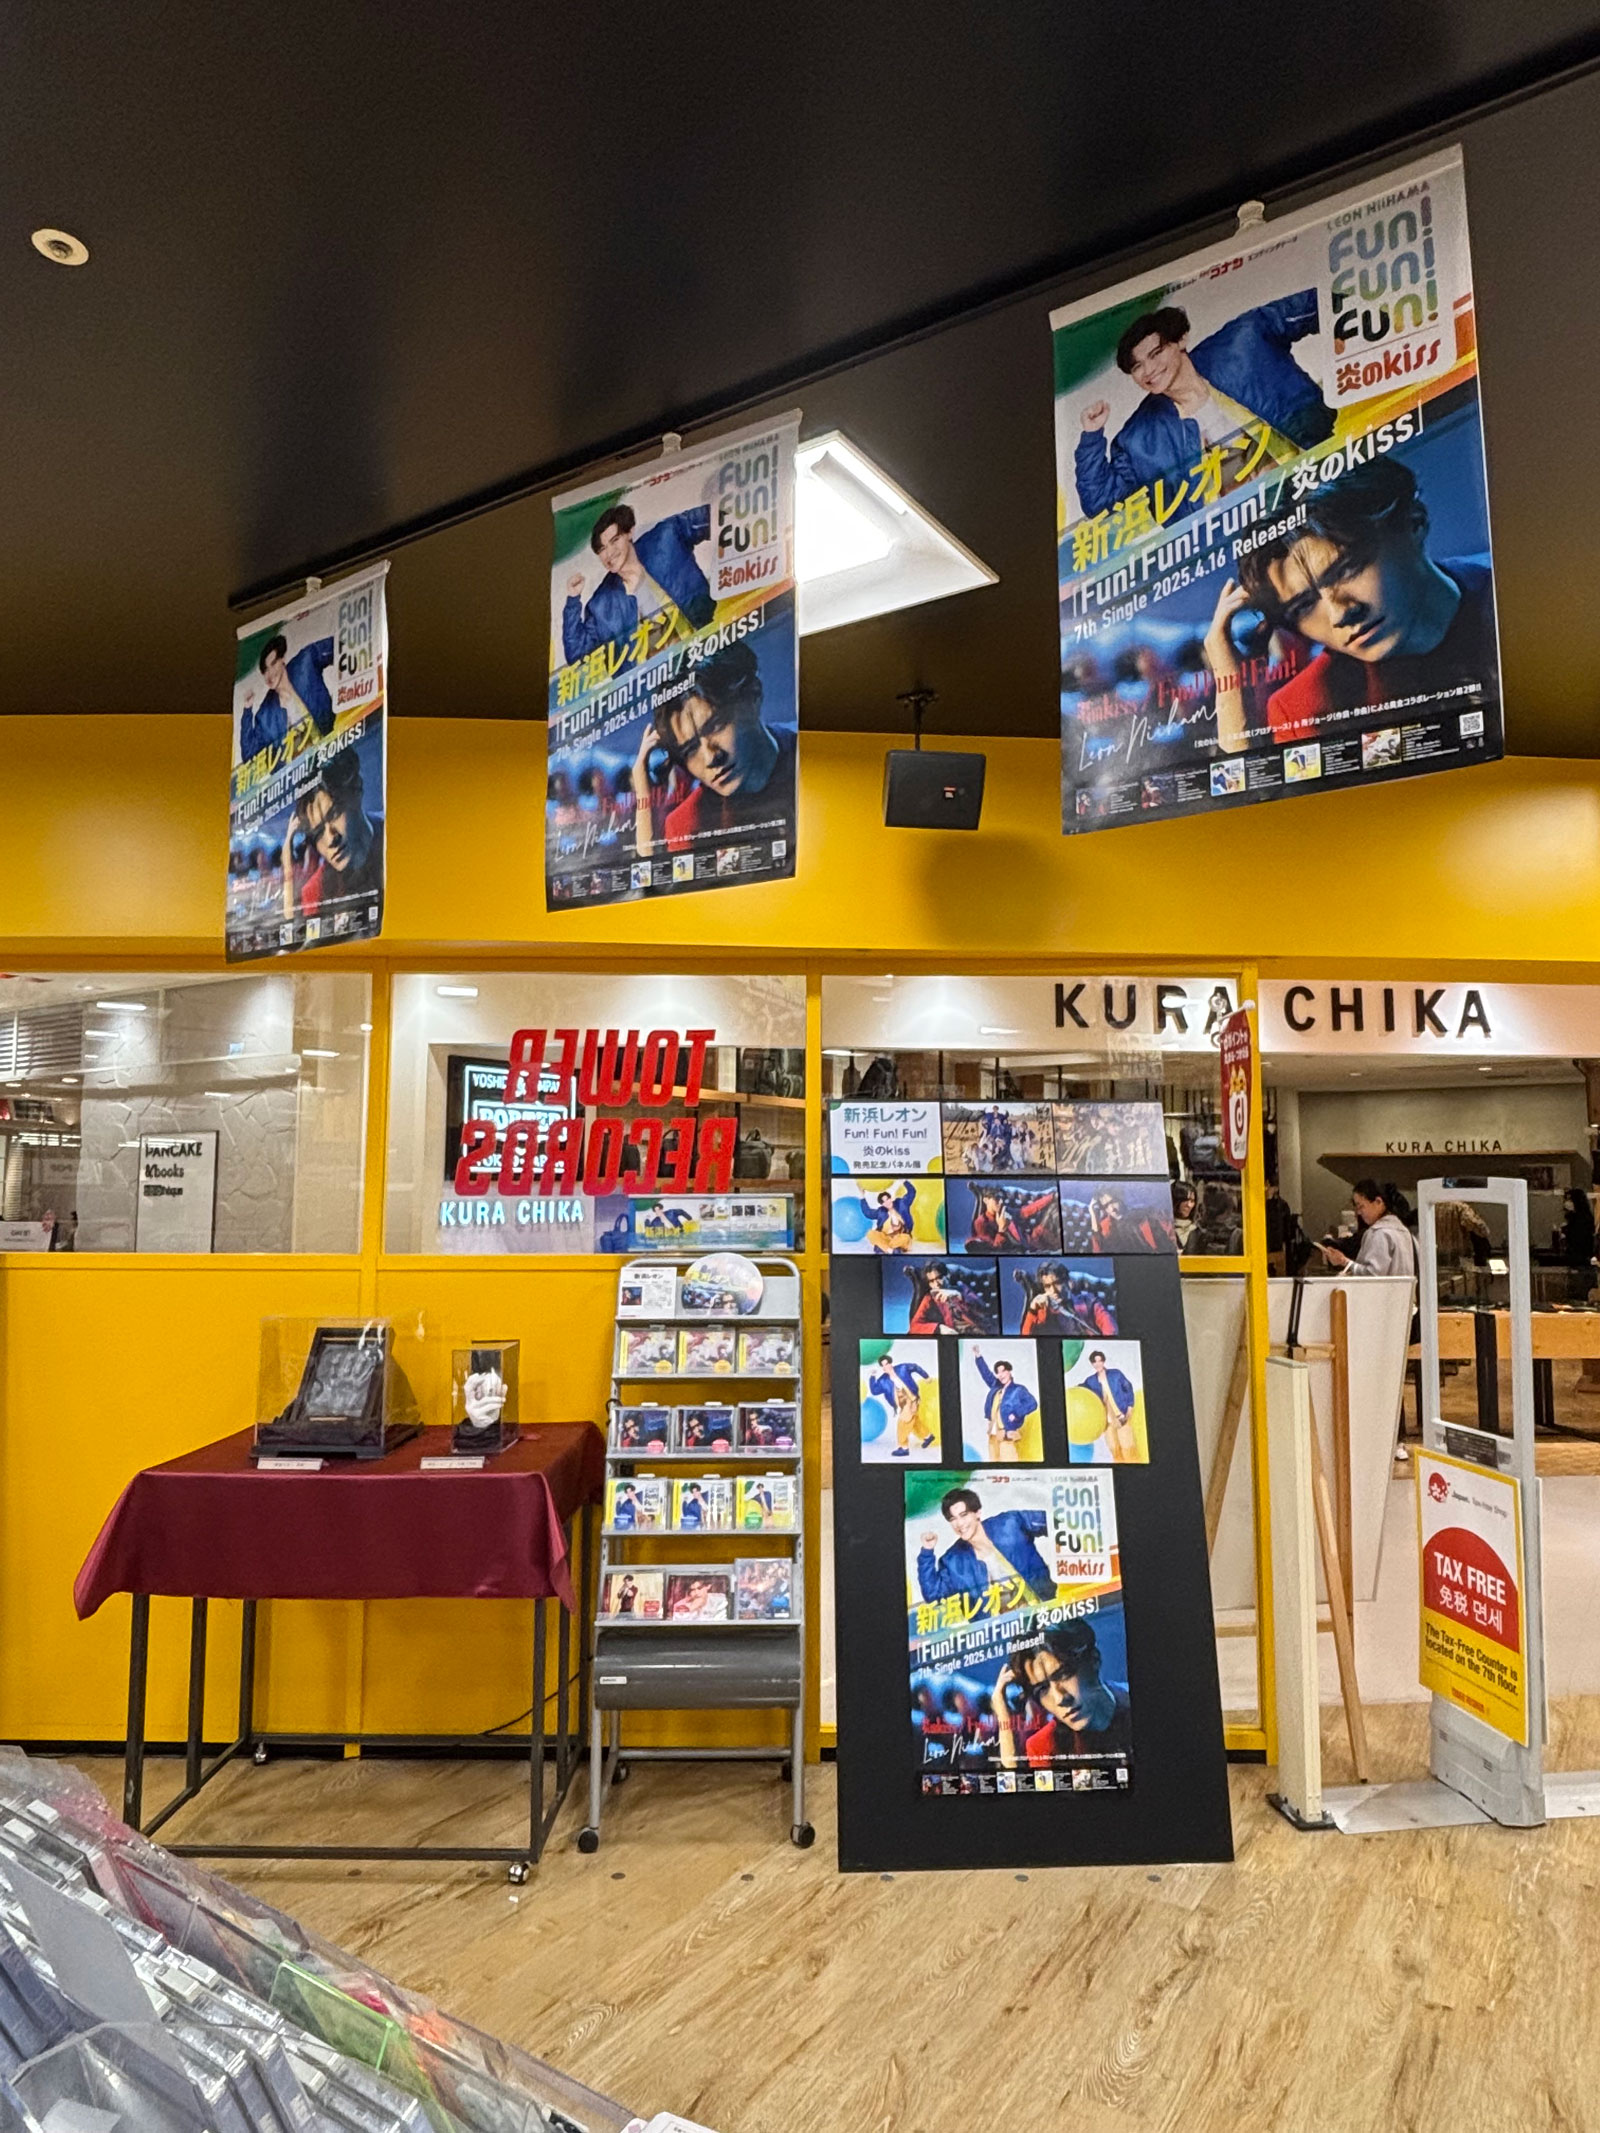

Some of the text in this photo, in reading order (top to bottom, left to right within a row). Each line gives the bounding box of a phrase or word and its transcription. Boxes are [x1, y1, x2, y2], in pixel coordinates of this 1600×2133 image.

[1072, 423, 1272, 573] 新浜レオン
[1074, 613, 1097, 644] 7th
[1101, 591, 1148, 629] Single
[1152, 552, 1227, 602] 2025.4.16
[557, 605, 680, 707] 新浜レオン
[1055, 983, 1491, 1037] KURA CHIKA
[844, 1107, 927, 1124] 新浜レオン
[844, 1129, 928, 1139] Fun! Fun! Fun!
[145, 1141, 202, 1157] PANCAKE
[863, 1145, 911, 1157] 炎のkiss
[1385, 1140, 1502, 1153] KURA CHIKA
[441, 1199, 584, 1226] KURA CHIKA
[1434, 1551, 1506, 1606] TAX FREE
[916, 1577, 1026, 1636] 新浜レオン
[1440, 1584, 1503, 1635] 免税 면세
[934, 1658, 962, 1677] Single
[963, 1646, 1004, 1667] 2025.4.16
[1425, 1636, 1454, 1660] located
[1455, 1653, 1466, 1666] on
[1467, 1658, 1480, 1675] the
[1482, 1665, 1496, 1683] 7th
[1426, 1622, 1518, 1681] The Tax-Free Counter is
